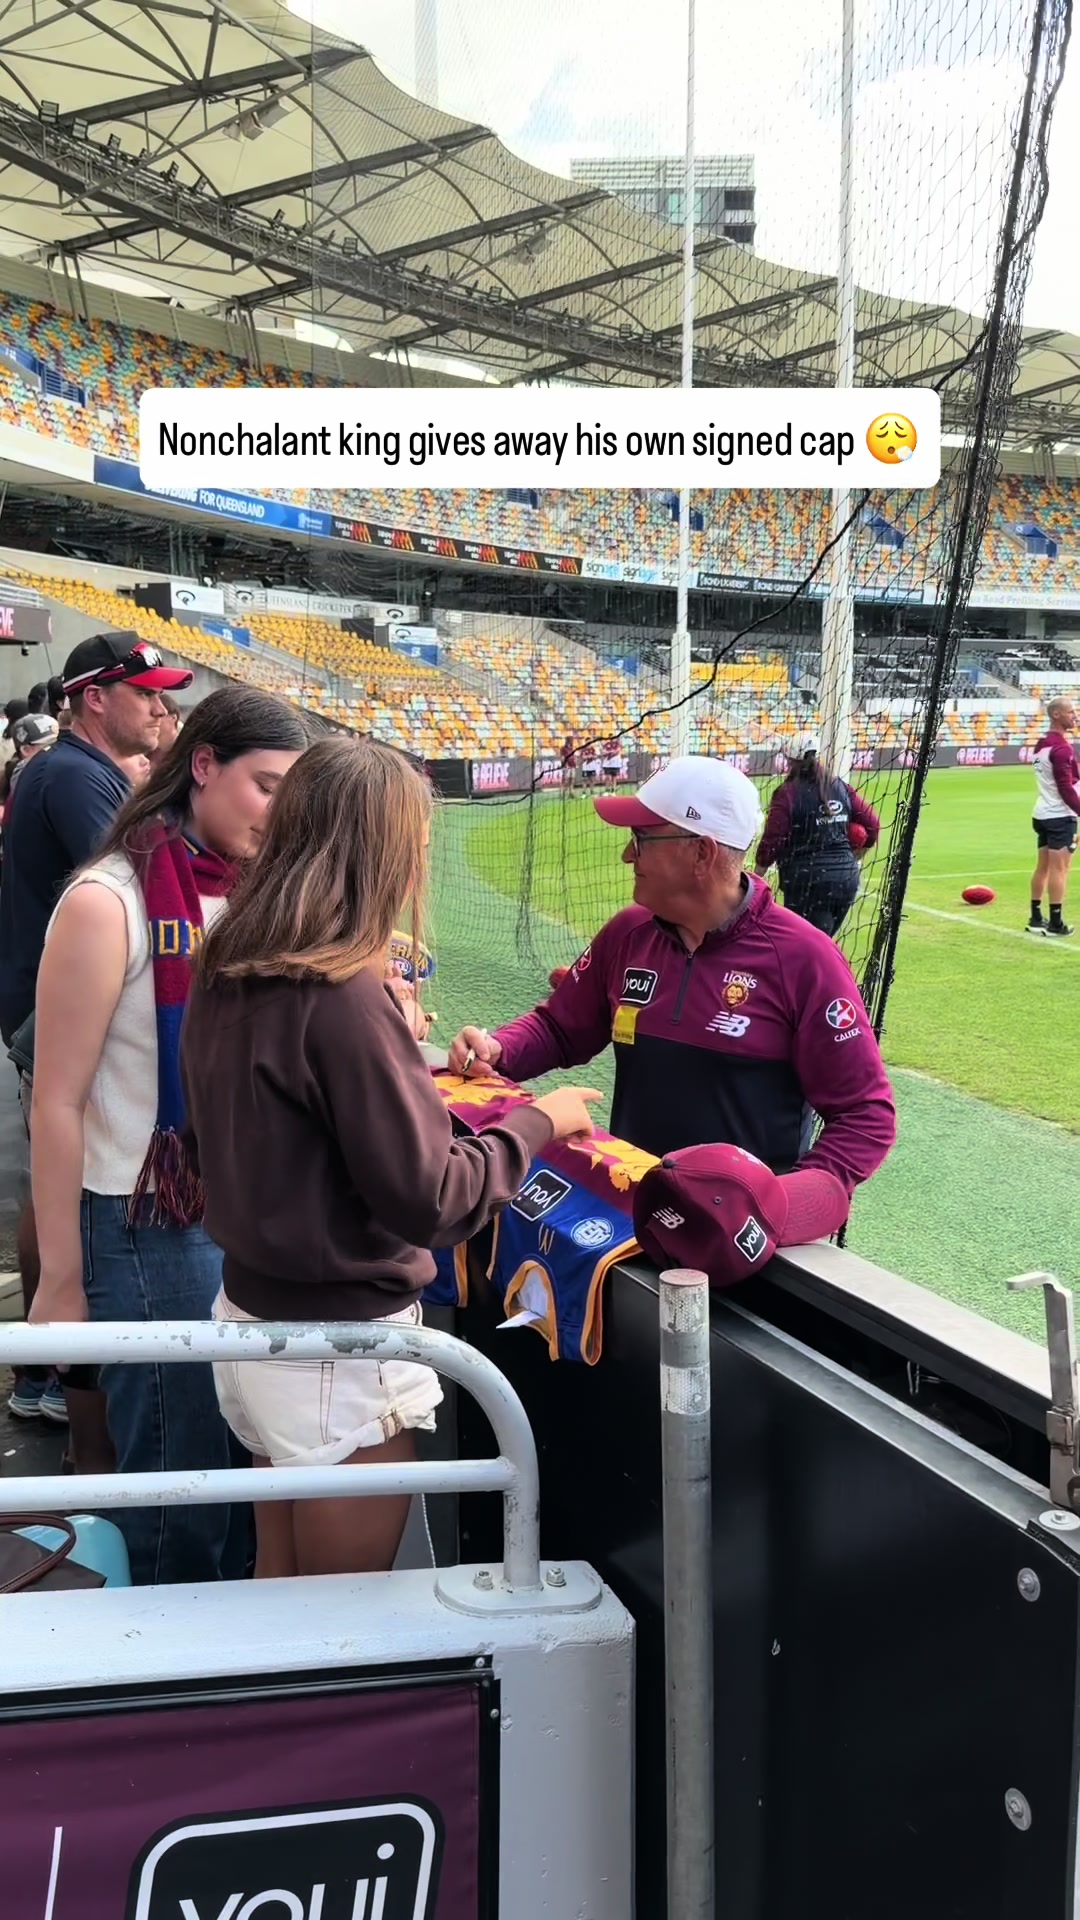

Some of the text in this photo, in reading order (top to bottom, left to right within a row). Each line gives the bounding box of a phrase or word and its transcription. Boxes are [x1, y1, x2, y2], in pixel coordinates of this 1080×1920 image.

[199, 489, 216, 507] FOR
[216, 494, 265, 518] QUEENSLAND
[623, 976, 653, 996] youi
[723, 972, 757, 989] LIONS
[834, 1027, 862, 1042] CALTEX
[742, 1221, 761, 1254] youi
